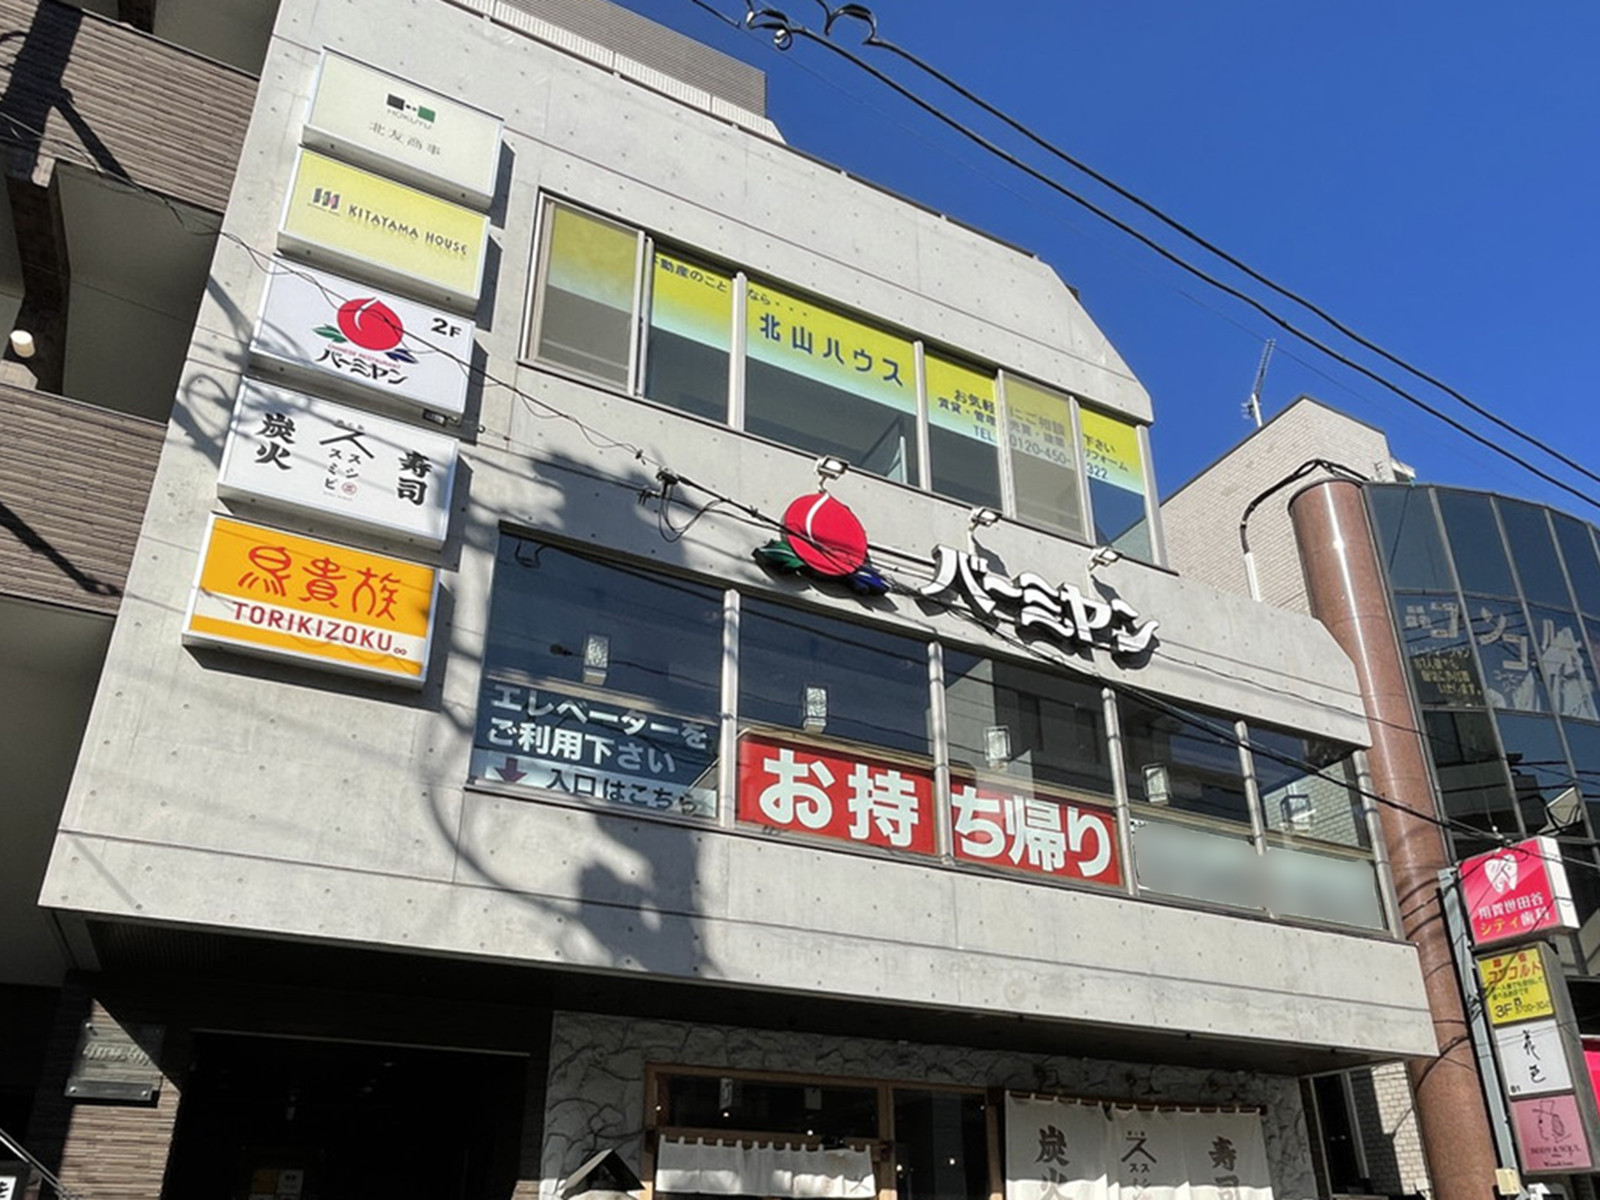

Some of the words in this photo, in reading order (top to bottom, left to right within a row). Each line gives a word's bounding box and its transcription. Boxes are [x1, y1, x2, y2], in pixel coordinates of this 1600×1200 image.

[368, 121, 441, 156] 北友商事
[348, 204, 419, 240] KITAYAMA
[424, 231, 468, 256] HOUSE
[430, 317, 463, 338] 2F
[759, 312, 904, 388] 北山ハウス
[314, 349, 408, 384] バーミヤン
[255, 412, 297, 471] 炭火
[396, 449, 433, 506] 寿司
[919, 543, 1161, 653] バーミヤン
[232, 600, 393, 652] TORIKIZOKU
[490, 684, 709, 750] エレベーターを
[488, 717, 676, 774] ご利用下さい
[546, 768, 698, 817] 入口はこちら
[1494, 1002, 1512, 1019] 3F
